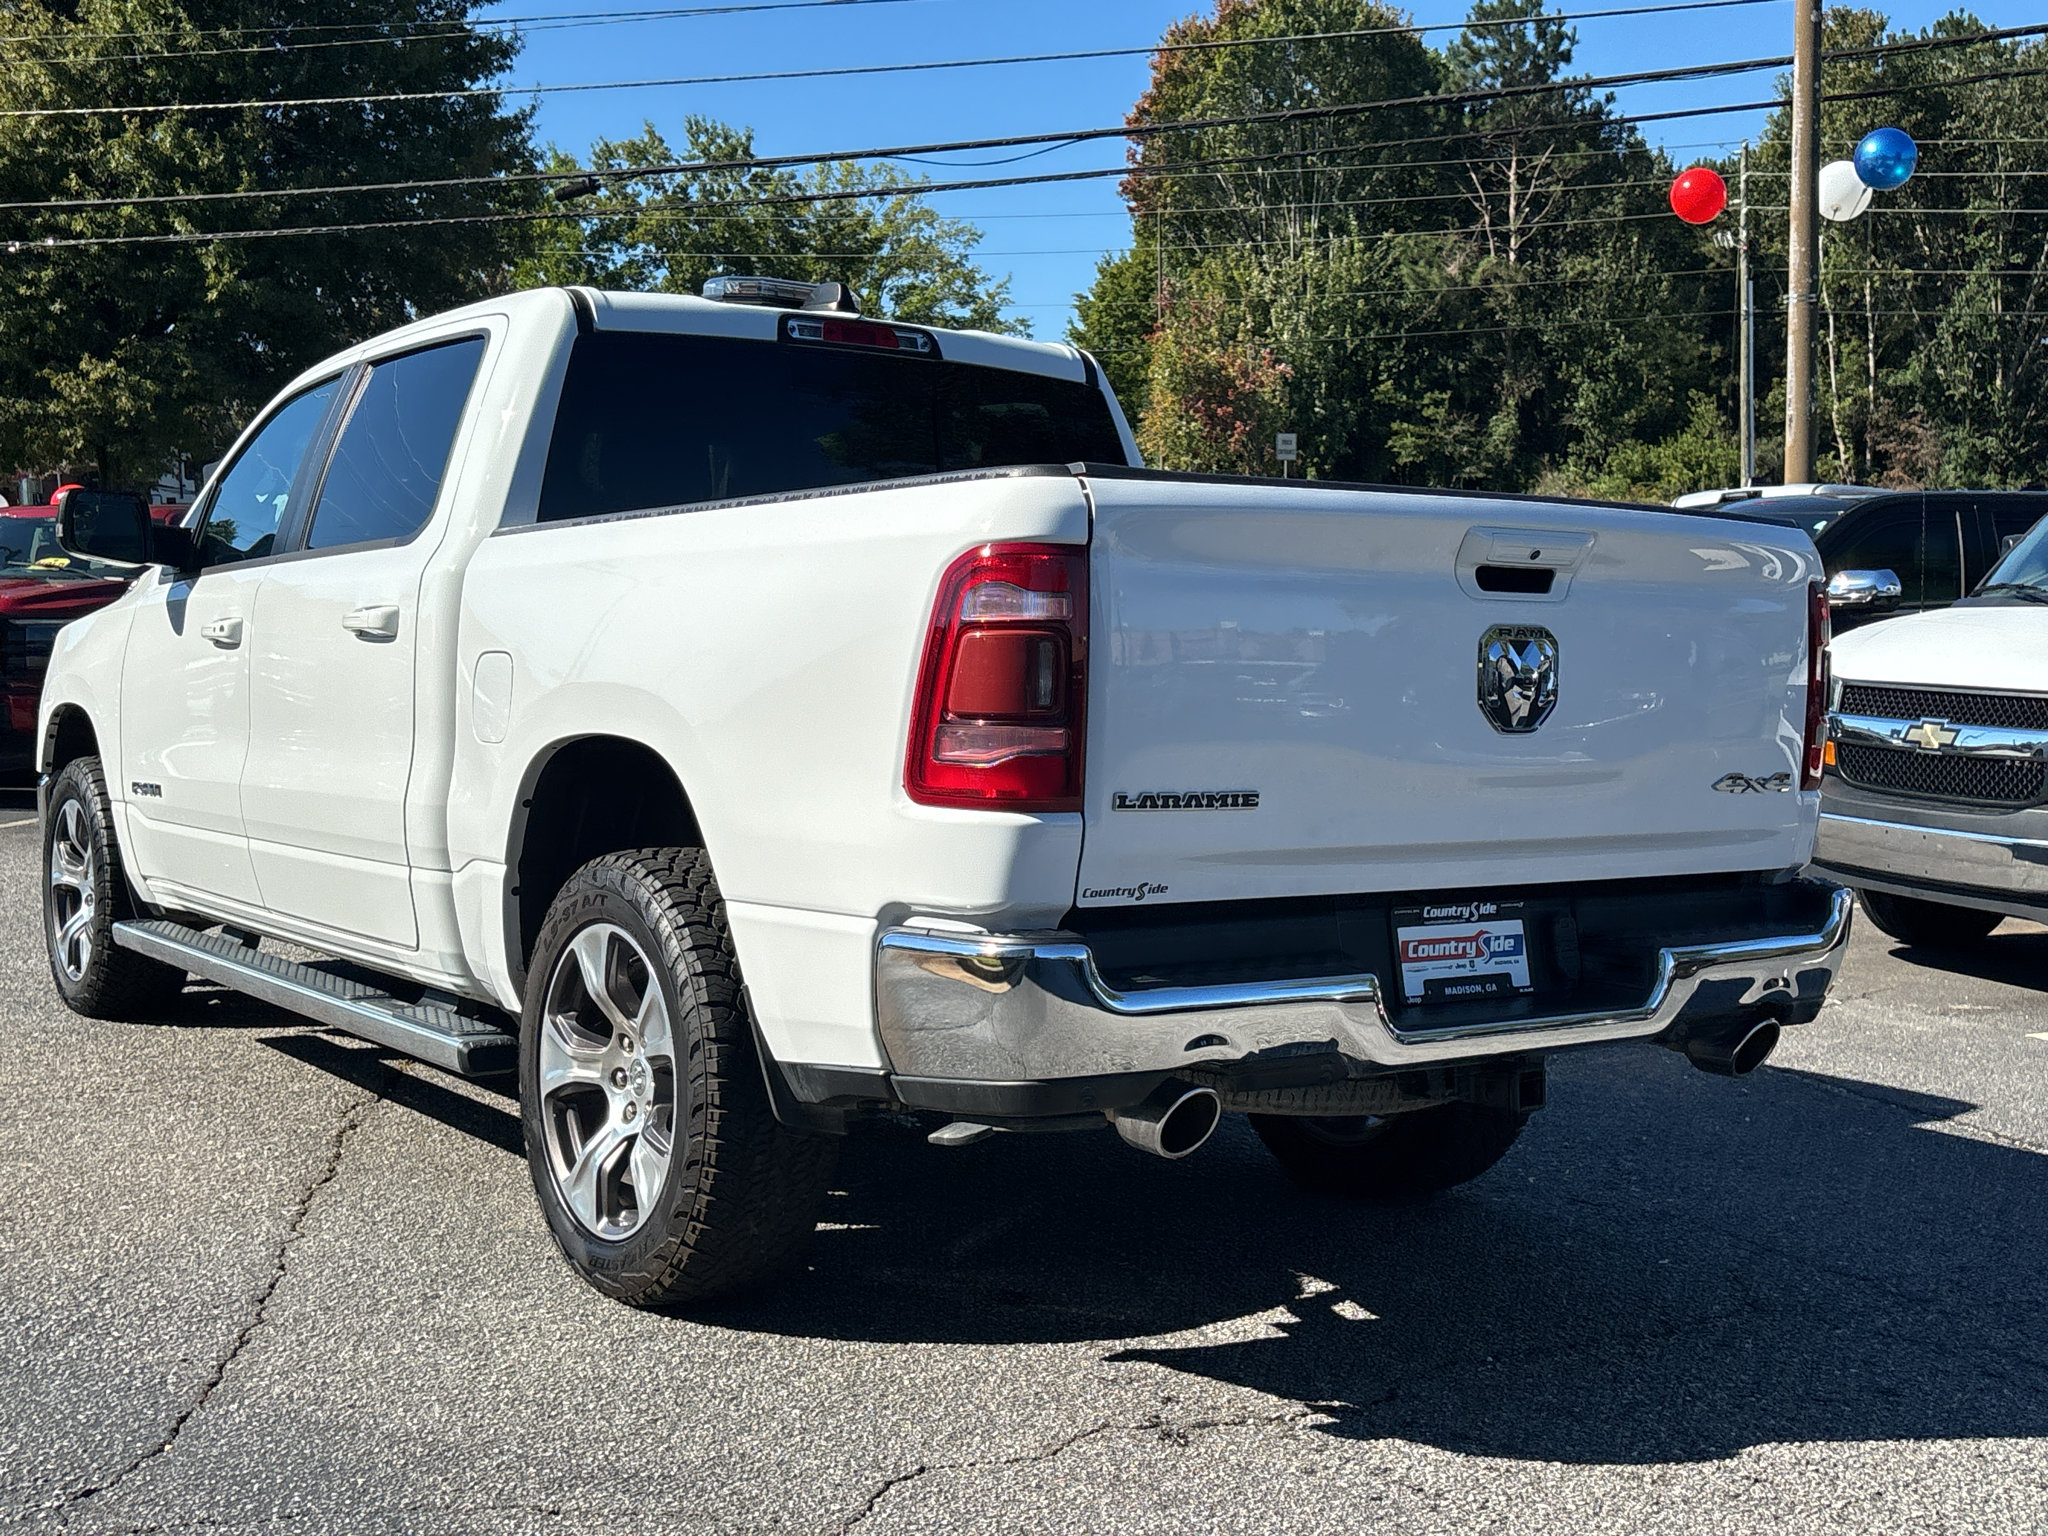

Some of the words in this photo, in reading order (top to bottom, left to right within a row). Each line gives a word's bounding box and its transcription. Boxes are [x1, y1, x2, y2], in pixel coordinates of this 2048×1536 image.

[1498, 627, 1545, 639] RAM
[1113, 791, 1260, 811] LARAMIE
[1445, 984, 1485, 996] MADISON,
[1486, 983, 1498, 992] GA
